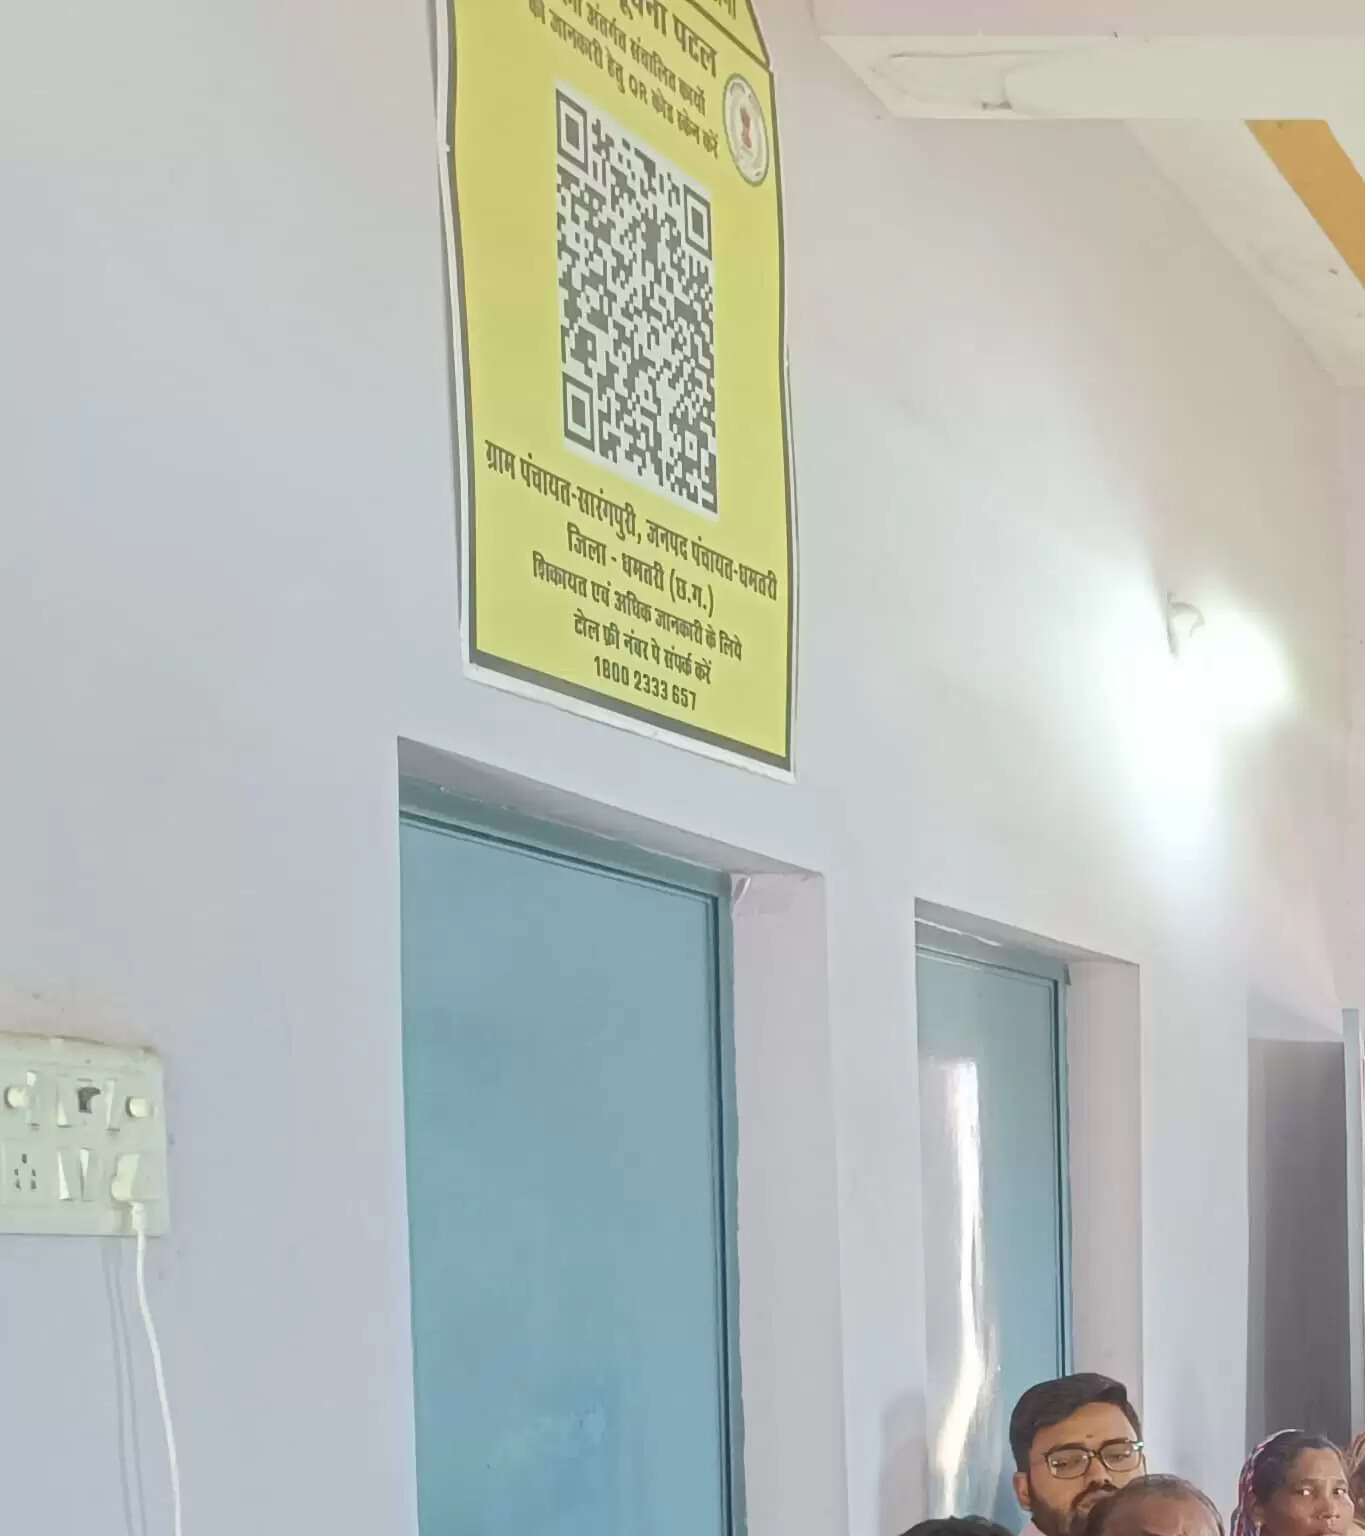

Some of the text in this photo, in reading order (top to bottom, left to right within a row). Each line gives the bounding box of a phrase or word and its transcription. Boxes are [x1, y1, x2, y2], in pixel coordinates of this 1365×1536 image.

[629, 74, 648, 104] QR
[485, 439, 515, 480] ग्राम
[646, 519, 688, 560] जनपद
[566, 522, 607, 566] जिला
[622, 552, 664, 591] धमतरी
[532, 550, 587, 598] शिकायत
[591, 581, 612, 607] एवं
[614, 590, 652, 623] अधिक
[655, 608, 703, 645] जानकारी
[705, 624, 716, 649] के
[573, 608, 600, 642] टोल
[623, 629, 649, 660] नंबर
[664, 645, 692, 676] संपर्क
[695, 658, 712, 684] करें
[594, 655, 697, 710] 1800 2333 657
